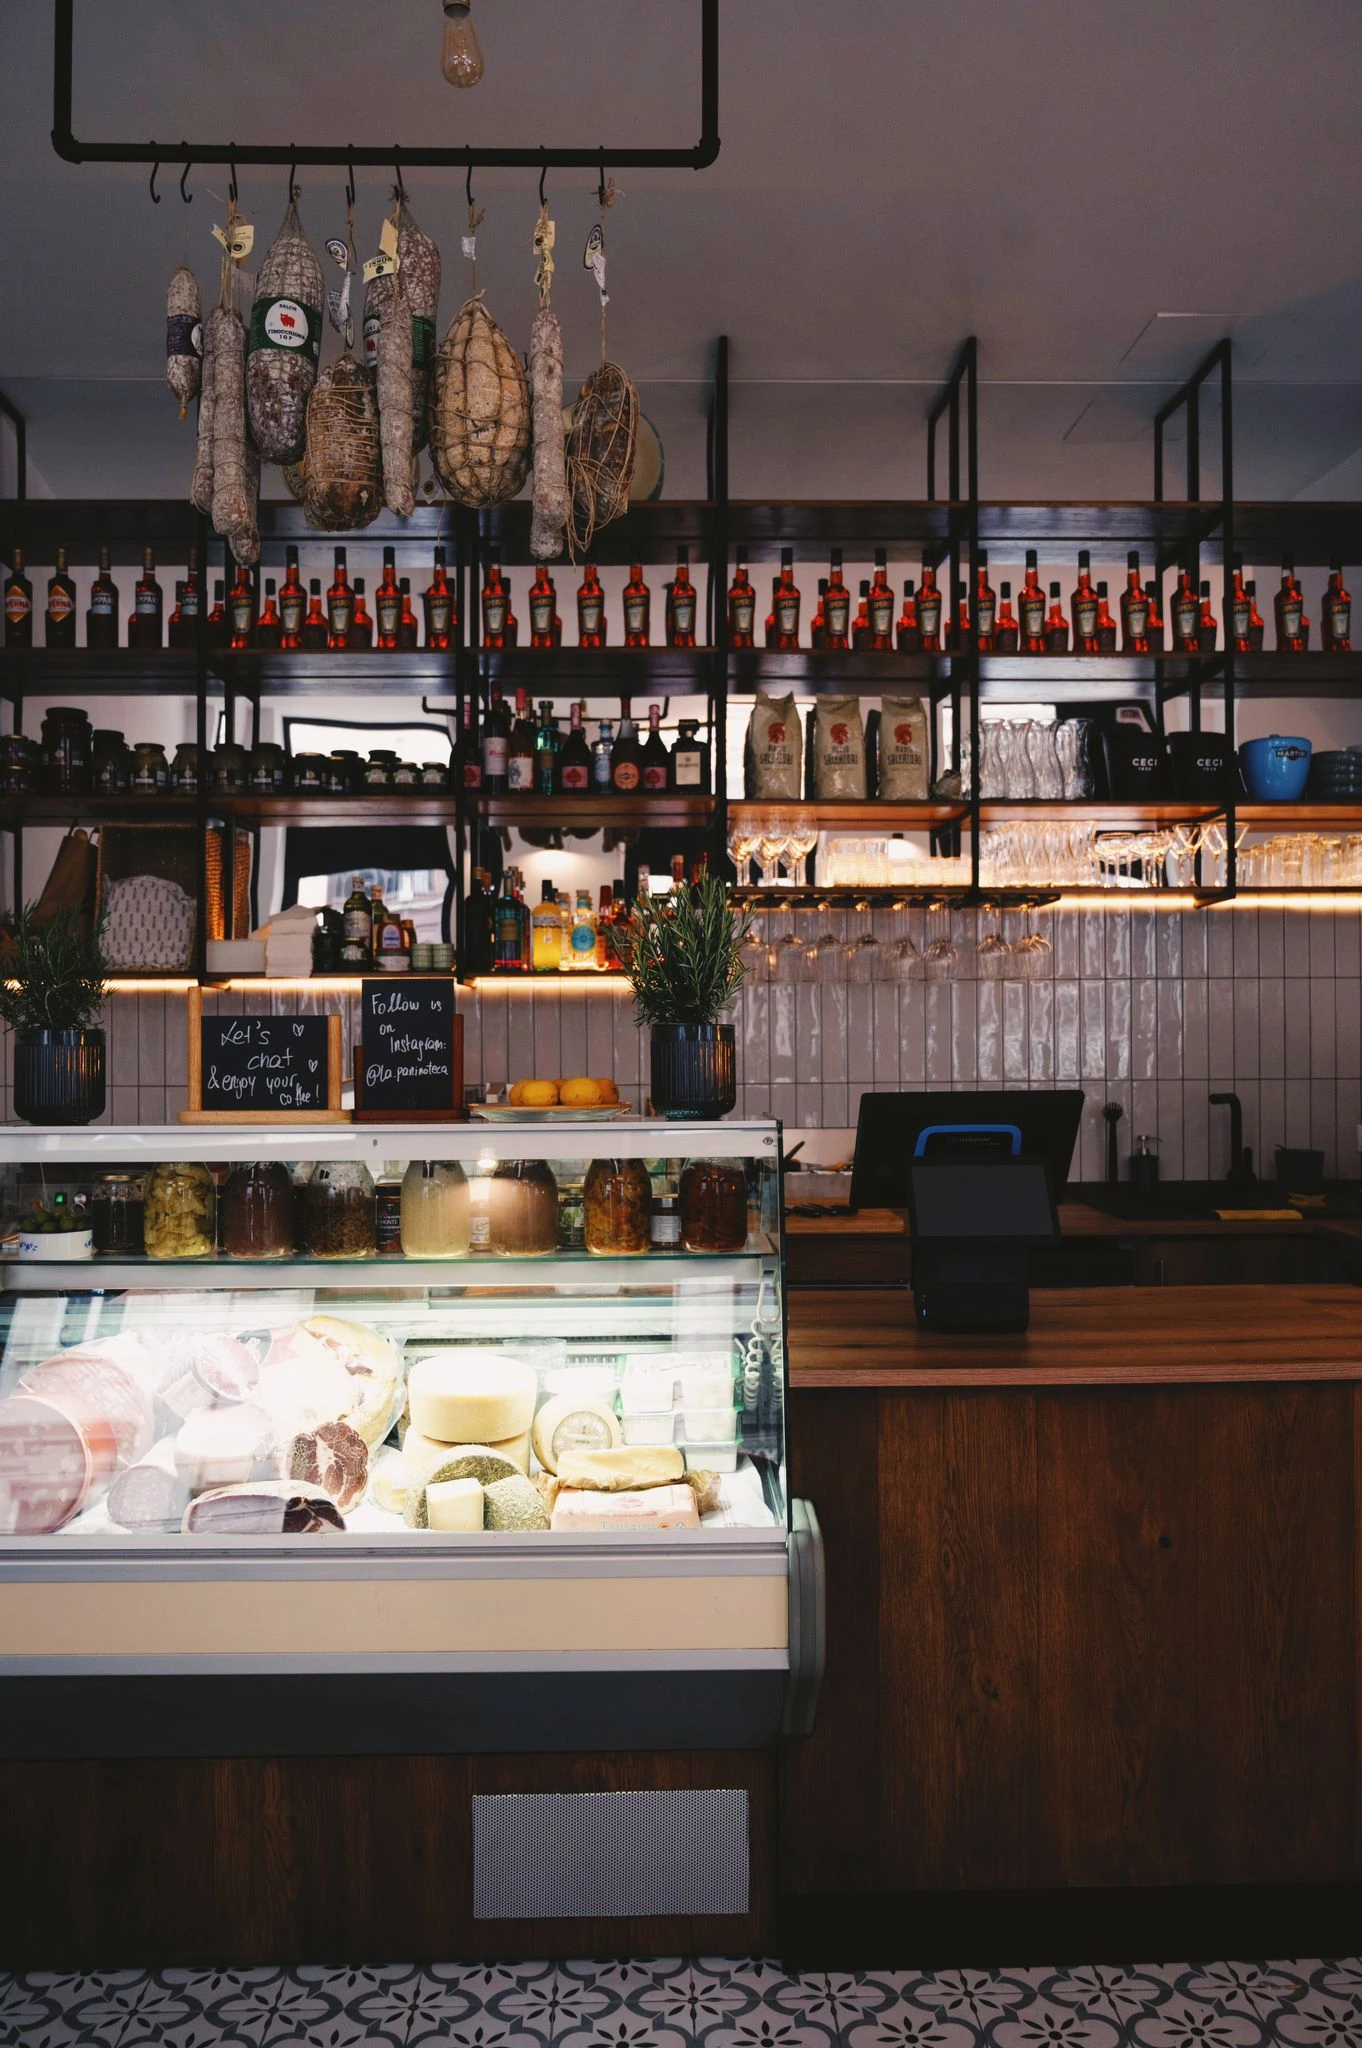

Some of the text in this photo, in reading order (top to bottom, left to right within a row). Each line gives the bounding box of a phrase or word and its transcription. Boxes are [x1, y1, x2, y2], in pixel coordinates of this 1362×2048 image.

[1131, 757, 1158, 767] CECI
[1196, 758, 1224, 767] CECI
[372, 992, 443, 1014] Follow us
[220, 1020, 271, 1046] Let's
[379, 1023, 396, 1036] on
[390, 1033, 447, 1061] Instagram:
[247, 1047, 294, 1070] chat
[266, 1073, 299, 1095] your
[366, 1060, 449, 1087] @la.paninoteca
